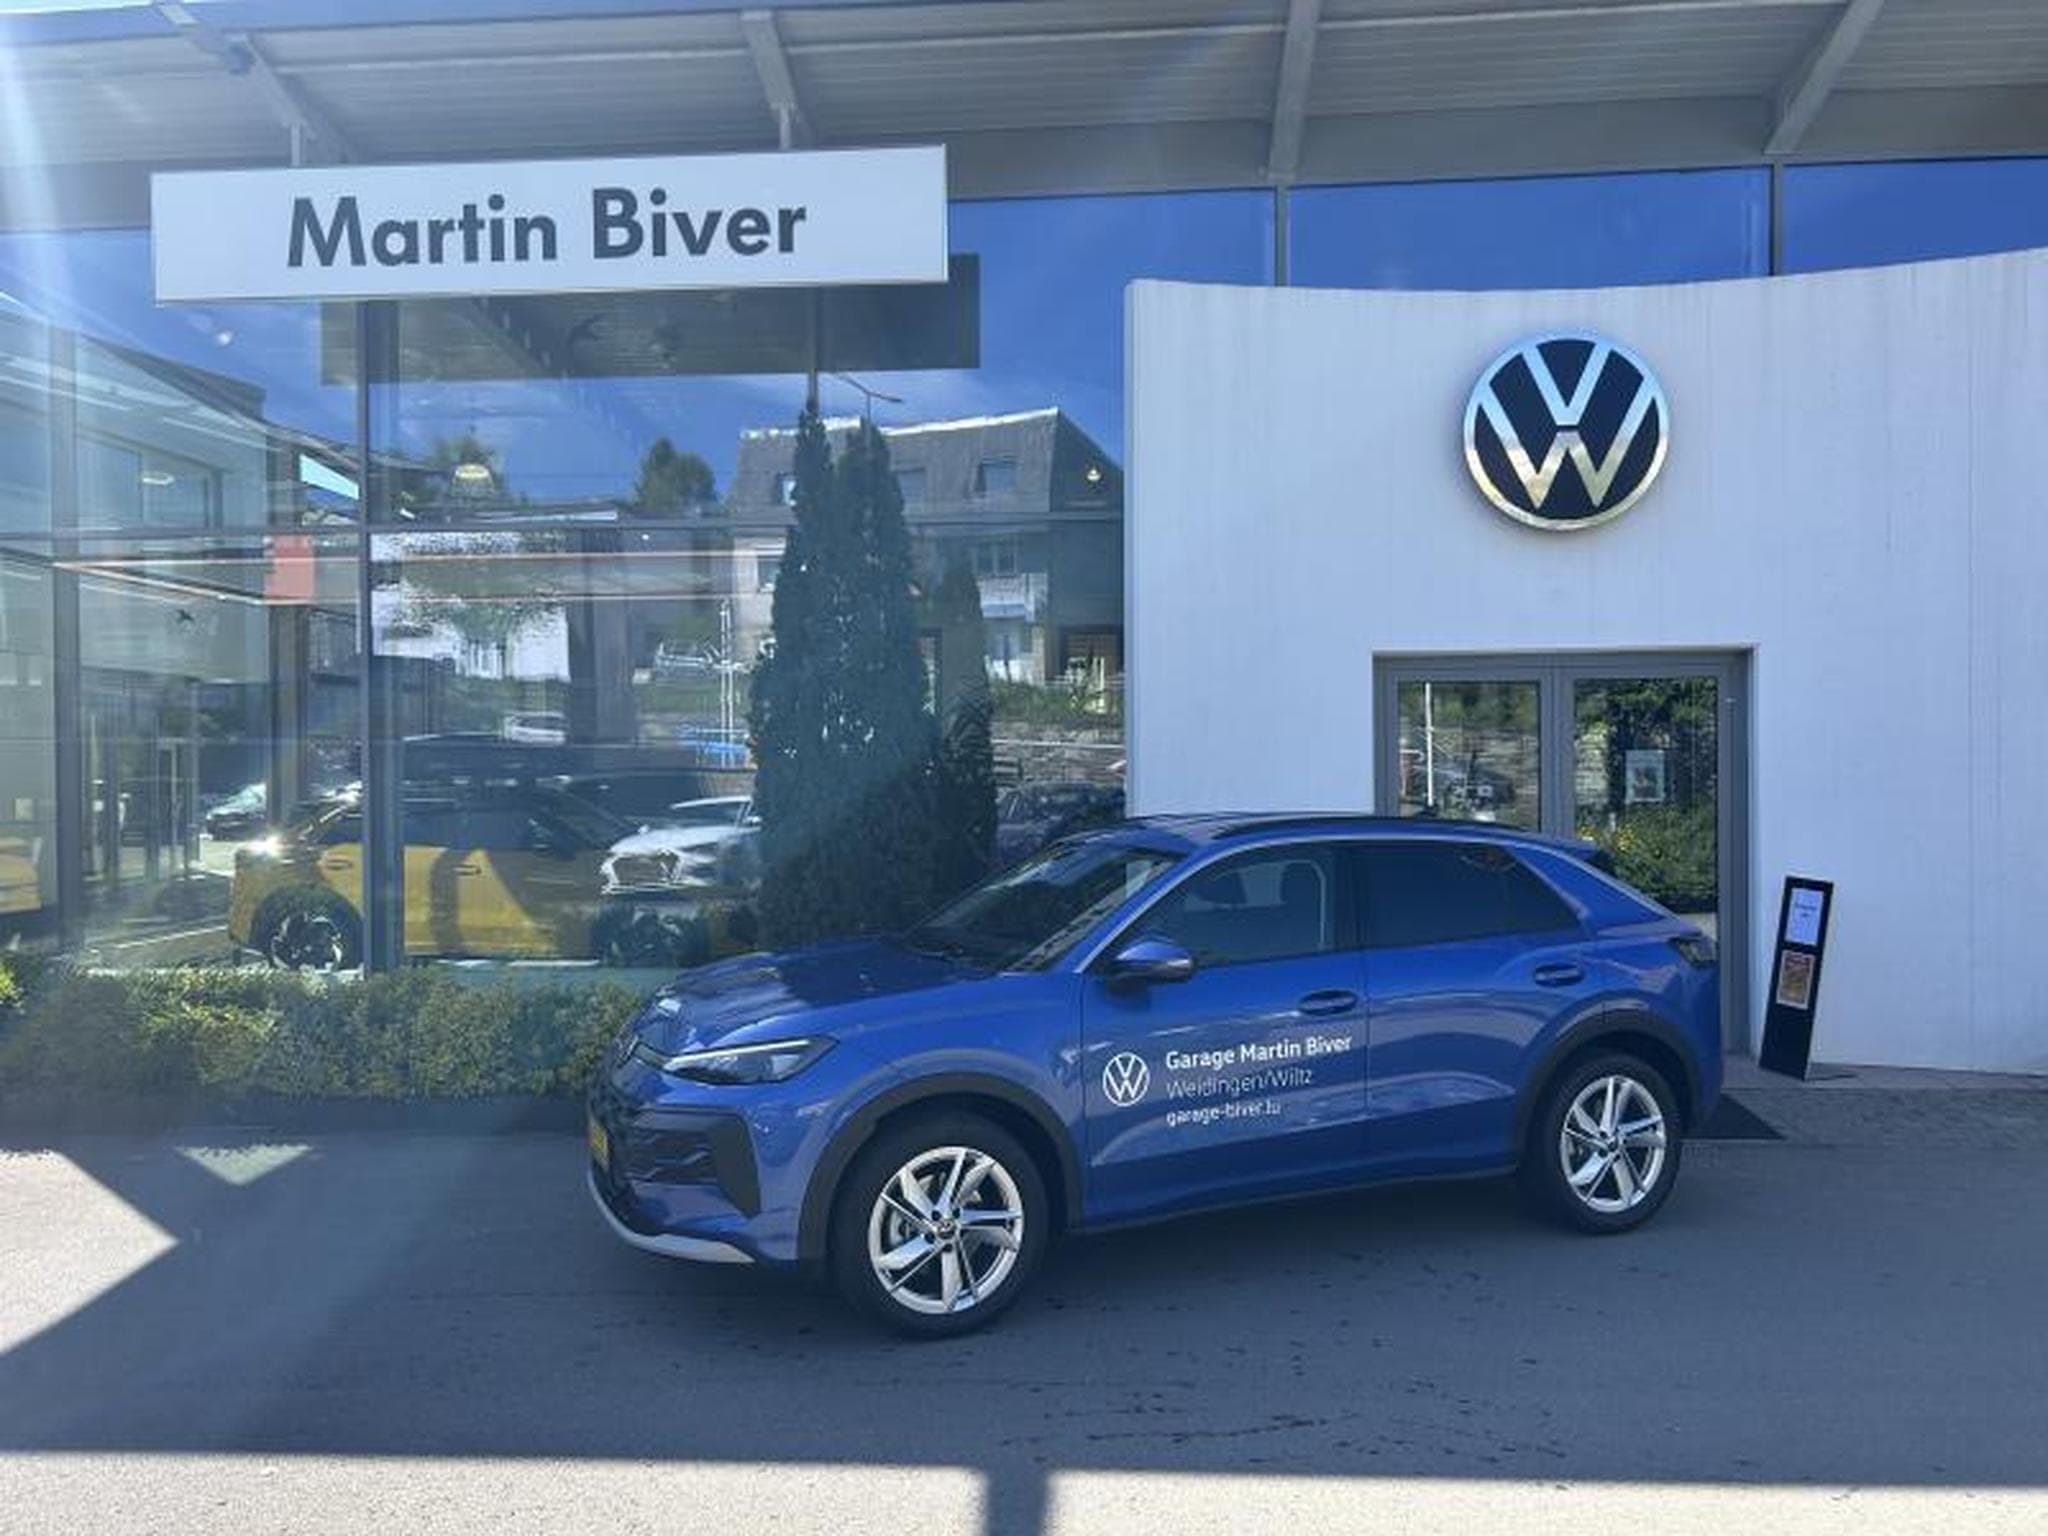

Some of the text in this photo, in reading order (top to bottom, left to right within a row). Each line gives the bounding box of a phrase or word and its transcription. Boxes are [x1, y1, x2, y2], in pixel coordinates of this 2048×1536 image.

[287, 187, 807, 268] Martin Biver
[1465, 335, 1668, 526] VW
[1166, 1036, 1353, 1071] Garage Martin Biver
[1103, 1052, 1149, 1107] VW
[1166, 1067, 1313, 1099] Weidingen/Wiltz
[1166, 1100, 1282, 1127] garage-biver.lu
